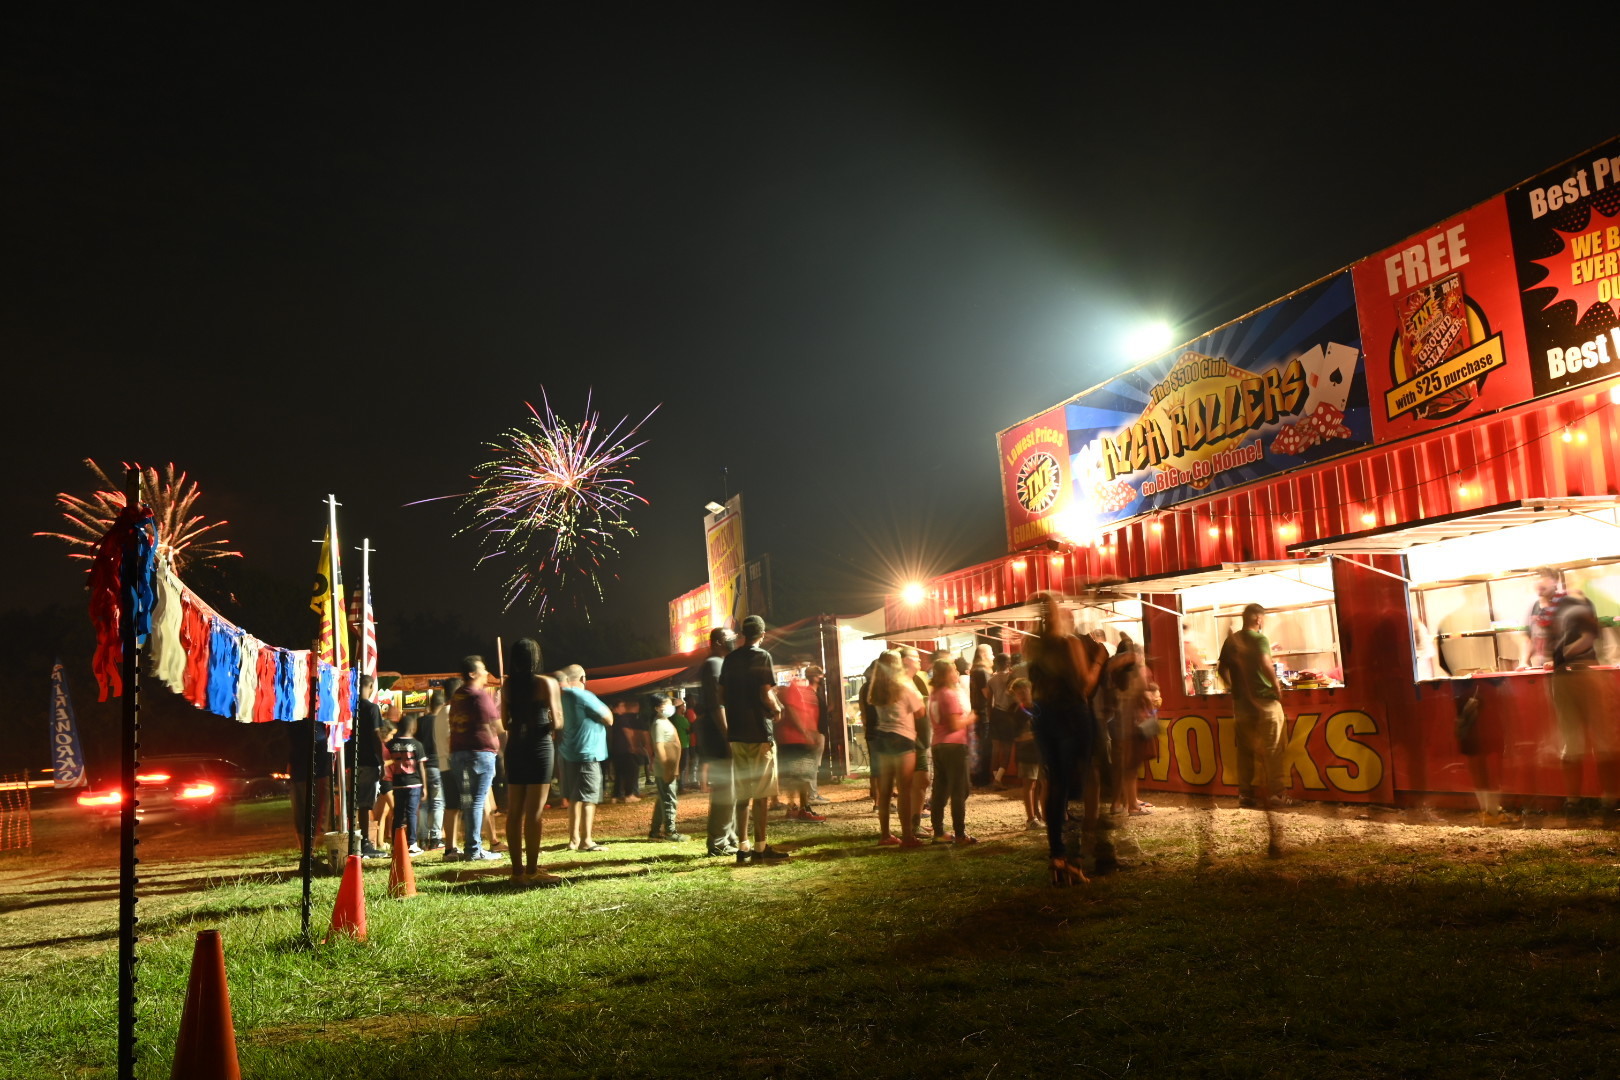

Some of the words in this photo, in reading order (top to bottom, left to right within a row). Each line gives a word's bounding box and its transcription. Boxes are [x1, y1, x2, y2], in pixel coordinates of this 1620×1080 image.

[1529, 168, 1590, 220] Best
[1384, 223, 1470, 297] FREE
[1571, 230, 1602, 260] WE
[1571, 250, 1620, 286] EVER
[1412, 298, 1436, 331] TNT
[1418, 315, 1452, 362] GROUND
[1424, 319, 1462, 369] BLASTER
[1547, 334, 1610, 380] Best
[1150, 380, 1171, 405] The
[1170, 362, 1200, 391] $500
[1201, 357, 1227, 379] Club
[1395, 390, 1417, 410] with
[1415, 371, 1442, 396] $25
[1443, 353, 1494, 388] purchase
[1101, 418, 1169, 482] HIGH
[1171, 359, 1309, 458] ROLLERS
[1006, 430, 1036, 467] Lowest
[1035, 426, 1065, 448] Prices
[1141, 481, 1156, 497] Go
[1155, 468, 1179, 493] BIG
[1180, 470, 1191, 485] or
[1192, 460, 1212, 480] Go
[1212, 439, 1263, 474] Home!
[1026, 458, 1053, 500] TNT
